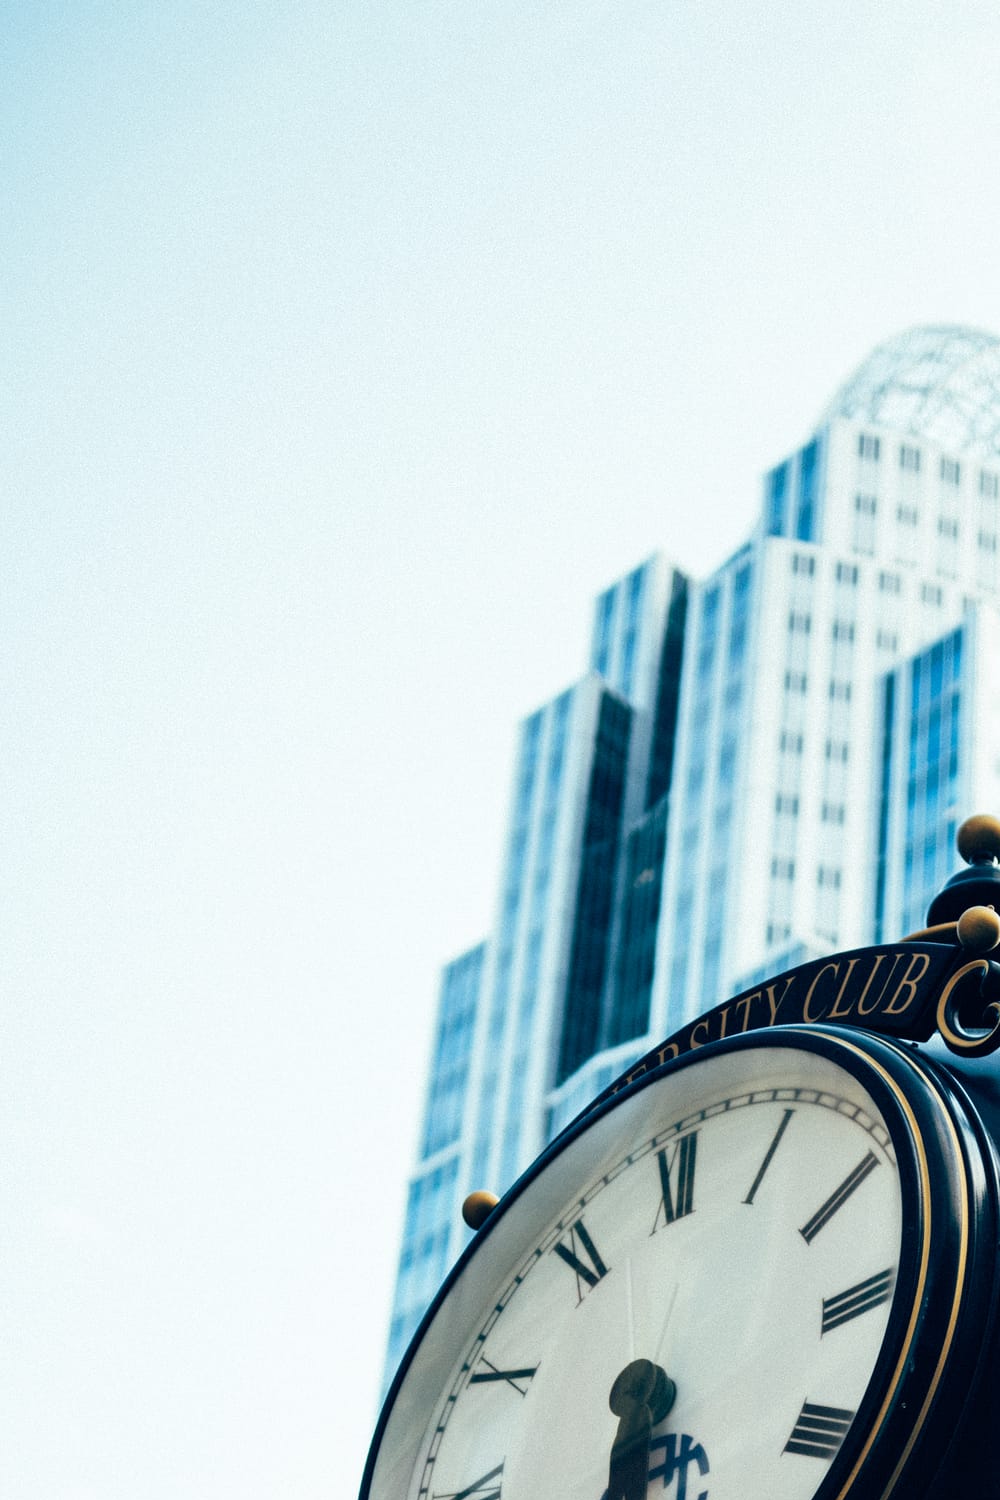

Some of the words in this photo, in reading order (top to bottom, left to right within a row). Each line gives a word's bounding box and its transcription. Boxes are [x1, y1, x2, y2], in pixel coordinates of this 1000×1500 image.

[802, 953, 931, 1025] CLUB
[648, 1128, 702, 1237] XII
[741, 1108, 797, 1206] I
[798, 1149, 882, 1246] II
[548, 1214, 612, 1310] XI
[820, 1266, 896, 1339] III
[466, 1351, 541, 1398] X
